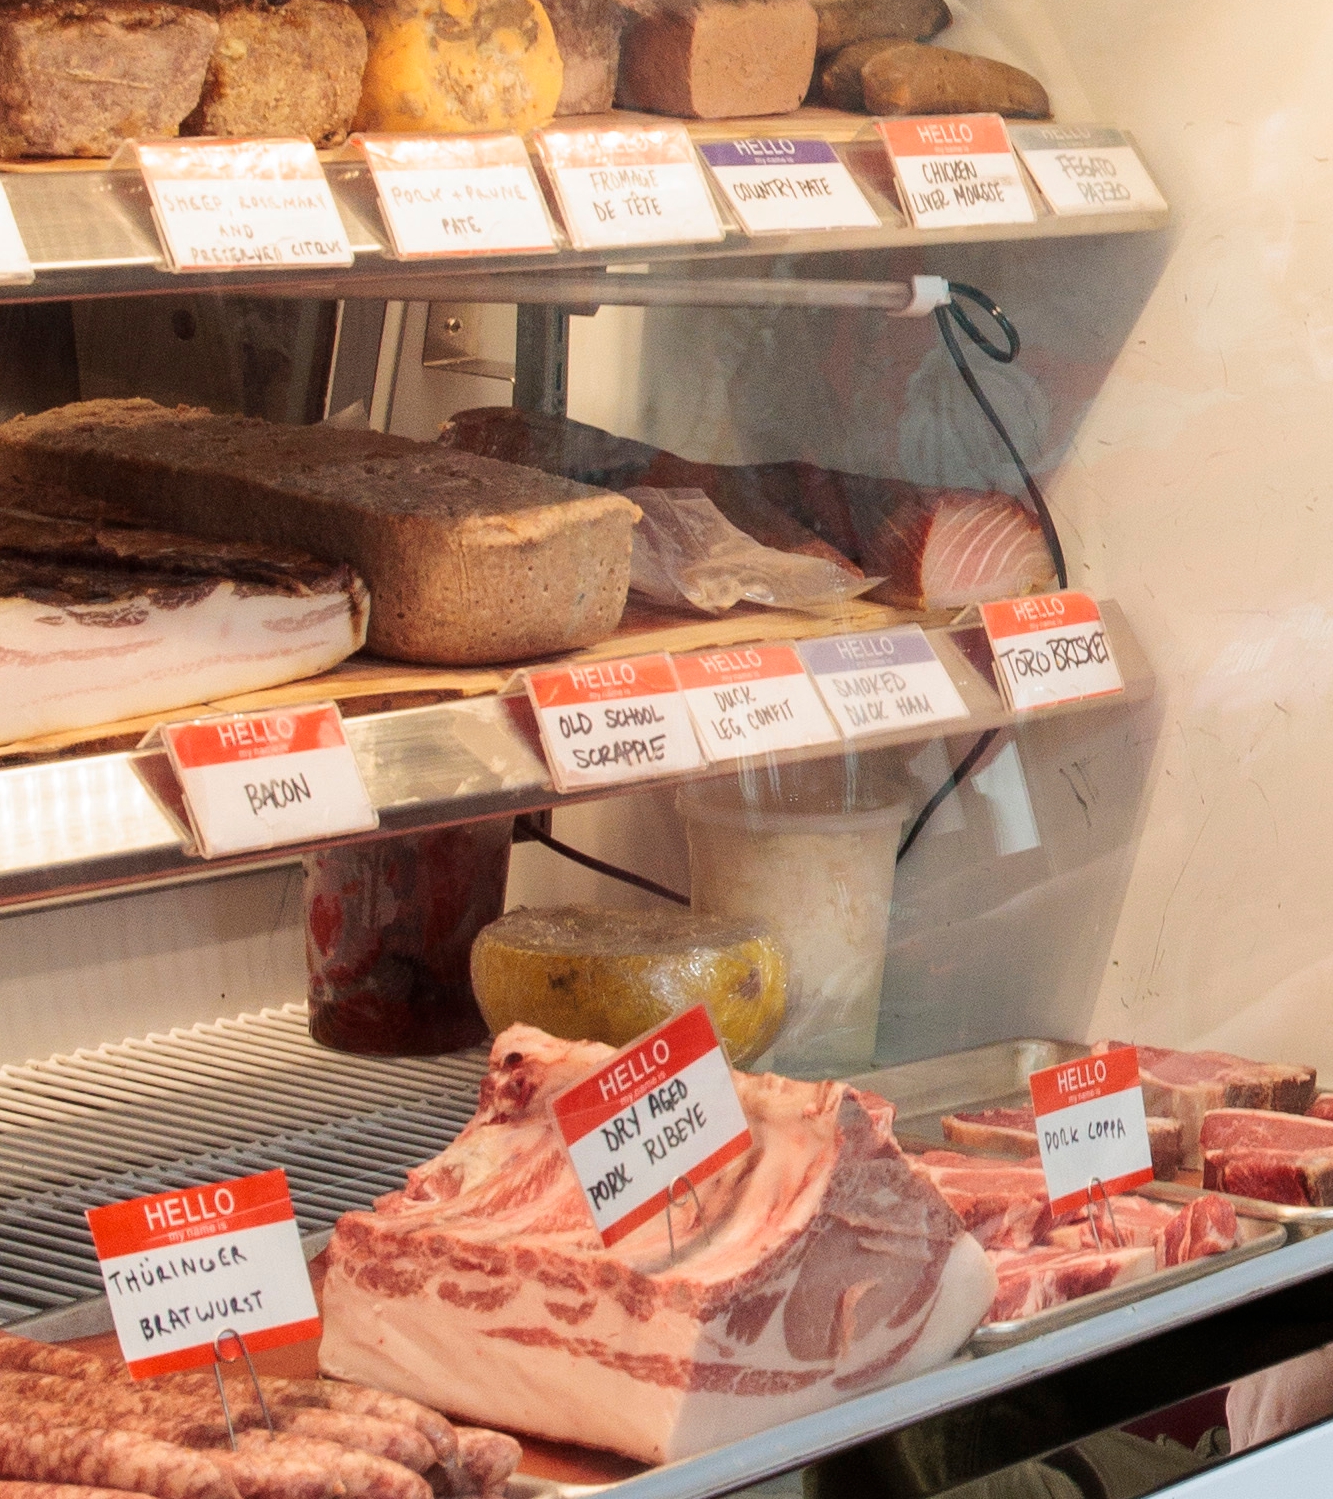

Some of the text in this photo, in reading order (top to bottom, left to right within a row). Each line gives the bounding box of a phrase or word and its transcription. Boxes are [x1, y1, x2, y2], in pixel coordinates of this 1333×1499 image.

[733, 139, 796, 156] HELLO
[916, 122, 974, 144] HELLO
[921, 159, 978, 184] CHICKEN
[391, 185, 444, 208] PORK
[465, 184, 528, 201] PRUNE
[592, 190, 662, 222] DE TÊTE
[733, 177, 832, 202] COUNTRY PATE
[911, 181, 1005, 215] LIVER MOUSSE
[219, 224, 254, 239] AND
[1012, 597, 1065, 622] HELLO
[698, 650, 763, 674] HELLO
[835, 636, 895, 659] HELLO
[1046, 631, 1110, 672] BRISKET
[569, 663, 636, 690] HELLO
[832, 670, 907, 698] SMOKED
[713, 685, 757, 713] DUCK
[844, 693, 935, 727] DUCK HAM
[216, 716, 296, 748] HELLO
[559, 704, 665, 739] OLD SCHOOL
[711, 699, 795, 741] LEG CONFIT
[572, 734, 667, 769] SCRAPPLE
[244, 773, 312, 816] BACON
[598, 1039, 670, 1101] HELLO
[1056, 1059, 1107, 1095] HELLO
[600, 1078, 689, 1152] DRY AGED
[1044, 1117, 1126, 1155] PORK COPPA
[587, 1102, 708, 1211] PORK RIBEYE
[143, 1188, 235, 1231] HELLO
[168, 1230, 185, 1244] my
[186, 1224, 215, 1238] name
[108, 1245, 248, 1296] THÜRINGER
[139, 1290, 263, 1342] BRATWURST
